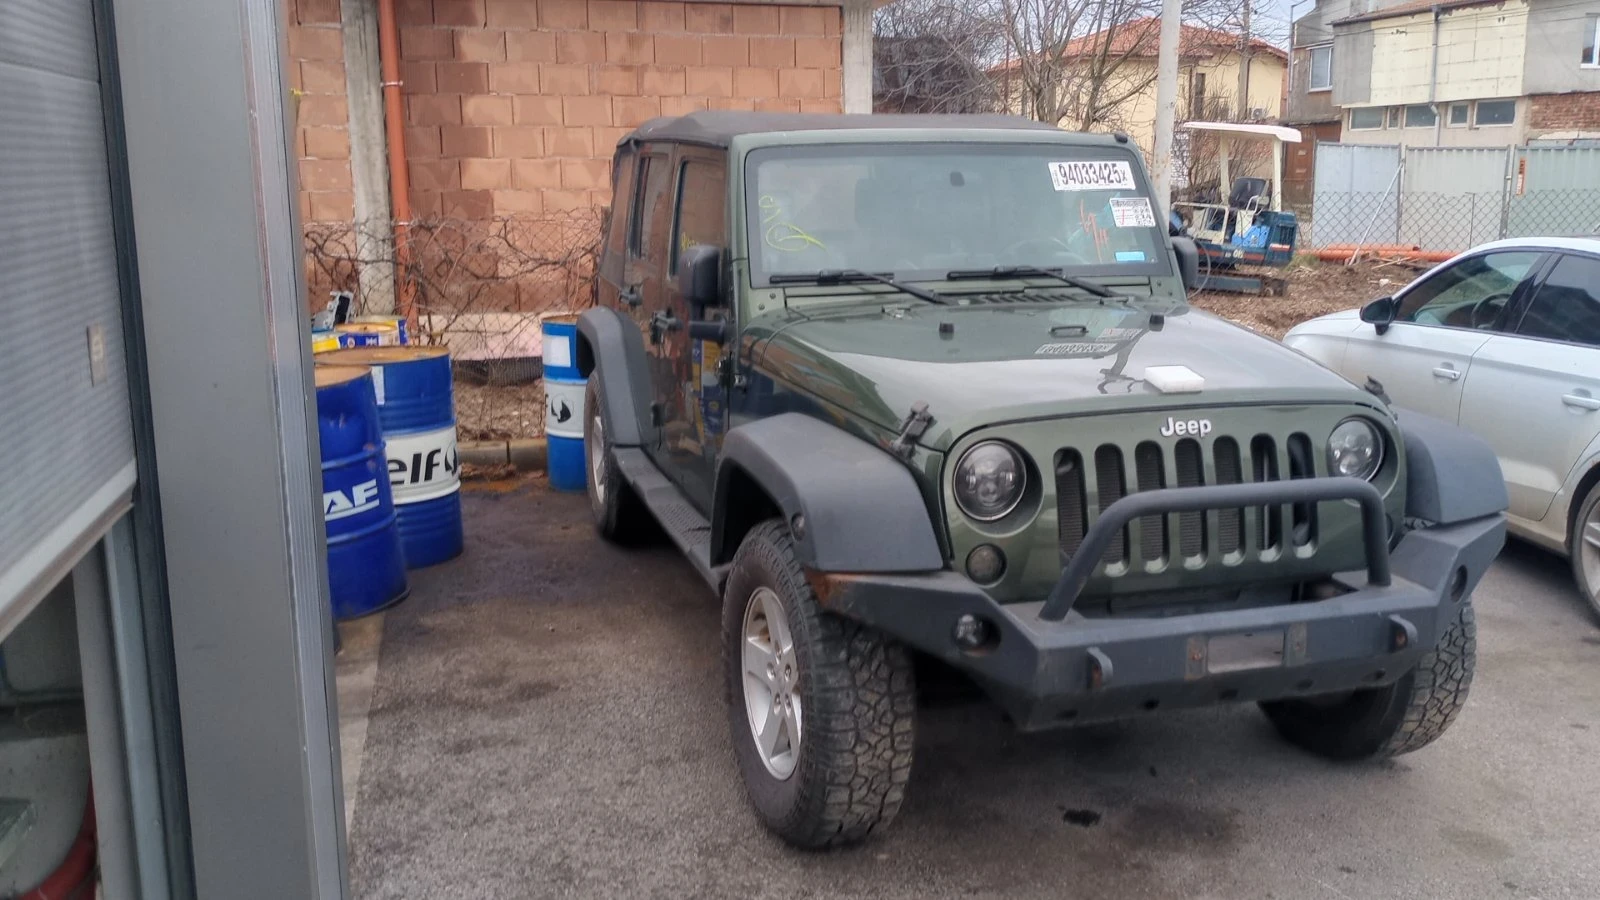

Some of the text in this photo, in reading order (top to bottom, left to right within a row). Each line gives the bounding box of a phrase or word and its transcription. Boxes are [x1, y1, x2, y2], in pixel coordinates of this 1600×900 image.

[1161, 417, 1212, 438] Jeep
[388, 449, 441, 485] elf
[323, 479, 377, 514] AF
